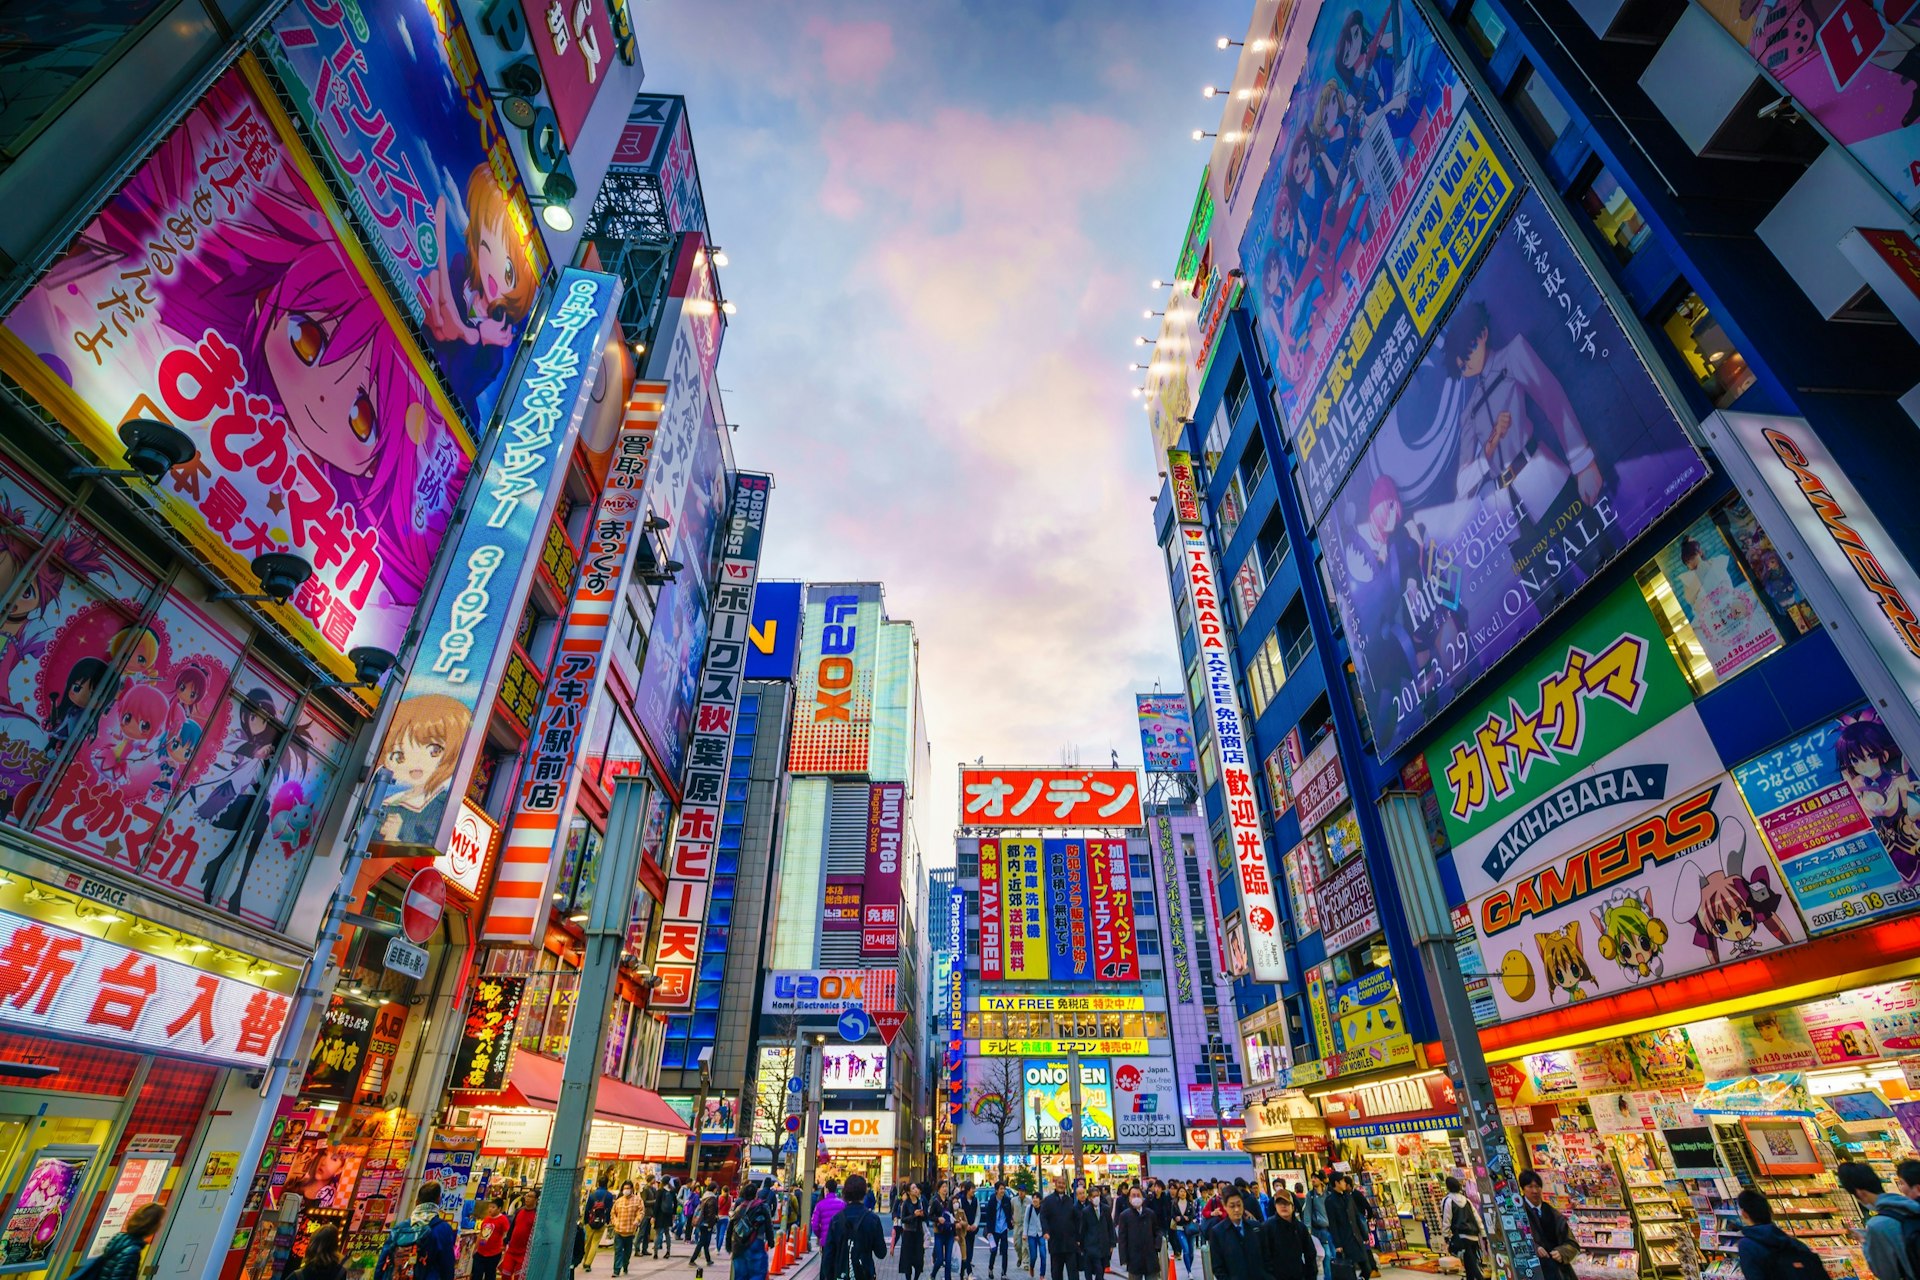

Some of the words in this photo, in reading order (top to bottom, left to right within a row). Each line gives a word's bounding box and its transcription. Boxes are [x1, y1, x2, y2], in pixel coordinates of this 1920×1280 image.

[73, 105, 281, 367] 魔法もあるんだよ
[1395, 201, 1444, 282] Blu-ray
[1441, 155, 1473, 196] Vol.
[1513, 213, 1609, 361] 未来を取り戻す。
[1299, 268, 1398, 461] 日本武道館
[727, 477, 753, 556] PARADISE
[746, 478, 767, 532] HOBBY
[1432, 506, 1495, 572] Grand
[1512, 535, 1550, 576] Blu-ray
[1556, 500, 1583, 532] DVD
[1402, 570, 1446, 633] Fate
[1464, 500, 1529, 571] Order
[1187, 551, 1224, 648] TAKARADA
[1392, 630, 1470, 723] 2017.3.29
[1503, 567, 1542, 618] ON
[1549, 495, 1618, 576] SALE
[526, 655, 598, 810] アキバ駅前店
[1214, 707, 1245, 765] 免税商店
[966, 771, 1135, 819] オノデン
[1775, 776, 1820, 804] SPIRIT
[879, 788, 903, 834] Duty
[1497, 768, 1644, 864] AKIHABARA
[870, 827, 880, 853] Store
[1224, 768, 1270, 896] 歓迎光臨
[879, 832, 900, 874] Free
[980, 844, 998, 880] 免税
[1481, 798, 1717, 934] GAMERS
[80, 879, 128, 907] ESPACE
[981, 882, 998, 917] TAX
[1330, 876, 1370, 917] COMPUTER
[1341, 898, 1374, 928] MOBILE
[866, 908, 895, 922] 免税
[951, 894, 963, 962] Panasonic
[865, 934, 895, 945] 면세점
[982, 922, 1000, 972] FREE
[0, 922, 291, 1058] 新台入替
[1102, 963, 1131, 977] 4F
[1358, 971, 1386, 990] DISCOUNT
[772, 1001, 794, 1009] Home
[797, 1001, 840, 1009] Electronics
[842, 1001, 864, 1009] Store
[951, 970, 962, 1030] ONODEN
[987, 999, 1014, 1010] TAX
[1018, 999, 1054, 1010] FREE
[1057, 998, 1090, 1010] 免税店
[1358, 981, 1391, 1001] COMPUTERS
[878, 1017, 901, 1026] 止まれ
[1063, 1025, 1121, 1038] MODFY
[1021, 1042, 1053, 1053] 冷蔵庫
[1748, 1053, 1781, 1066] 2017.4.30
[1026, 1067, 1106, 1085] ONOEN
[1147, 1066, 1170, 1074] Japan.
[1155, 1084, 1173, 1092] Shop
[1358, 1078, 1434, 1118] TAKARADA
[1027, 1126, 1111, 1139] AKIHARA
[1119, 1124, 1176, 1137] ONODEN
